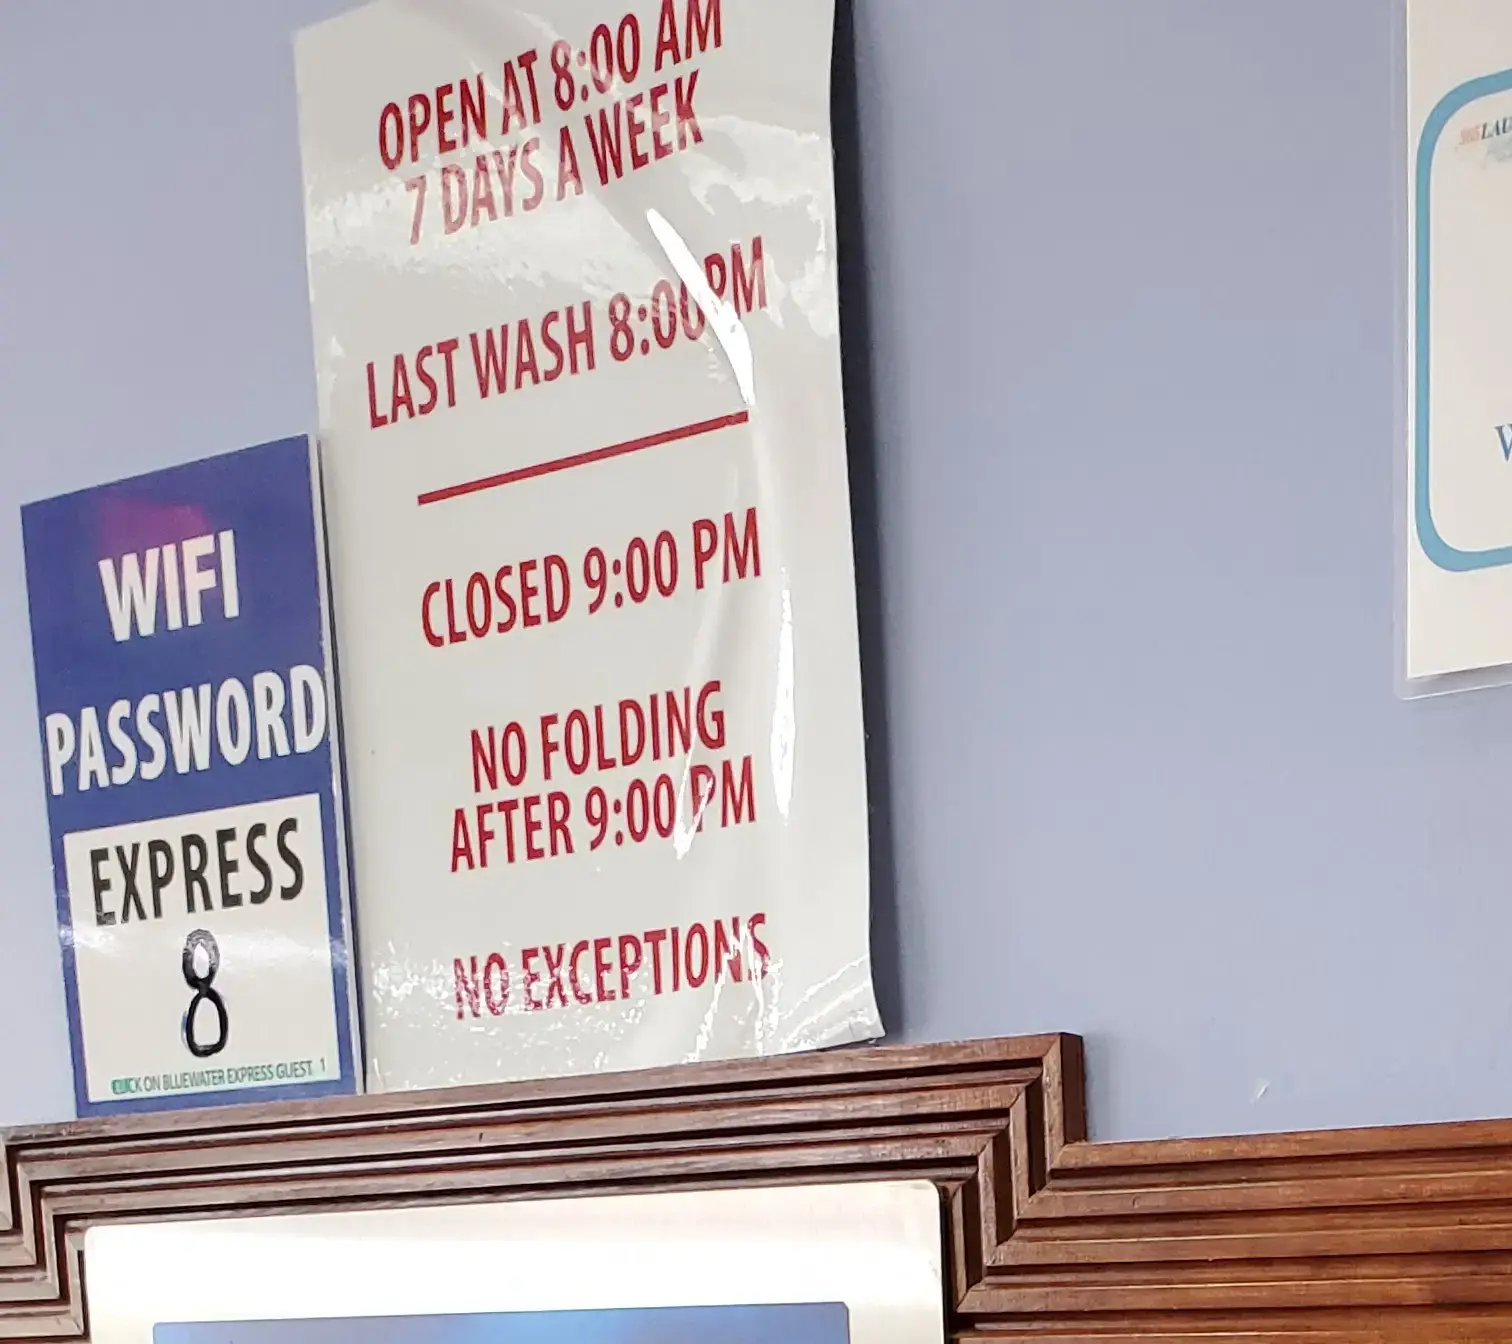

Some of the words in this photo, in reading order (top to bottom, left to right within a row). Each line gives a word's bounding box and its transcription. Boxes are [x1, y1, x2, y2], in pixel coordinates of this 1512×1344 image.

[379, 72, 487, 170] OPEN
[501, 50, 542, 135] AT
[551, 13, 640, 111] 8:00
[653, 0, 723, 71] AM
[405, 176, 427, 245] 7
[443, 137, 544, 236] DAYS
[556, 126, 584, 202] A
[584, 69, 704, 186] WEEK
[366, 339, 457, 430] LAST
[469, 301, 596, 399] WASH
[609, 279, 708, 362] 8:00
[703, 236, 769, 321] PM
[98, 529, 240, 642] WIFI
[422, 553, 571, 647] CLOSED
[583, 530, 678, 615] 9:00
[692, 506, 762, 590] PM
[45, 664, 326, 796] PASSWORD
[470, 722, 527, 793] NO
[540, 680, 726, 780] FOLDING
[89, 816, 304, 926] EXPRESS
[450, 791, 573, 873] AFTER
[585, 773, 676, 850] 9:00
[690, 755, 757, 832] PM
[181, 928, 229, 1058] 8
[452, 953, 512, 1020] NO
[520, 912, 771, 1014] EXCEPTIONS
[143, 1074, 161, 1092] ON
[162, 1069, 226, 1090] BLUEWATER
[226, 1063, 275, 1084] EXPRESS
[275, 1059, 313, 1079] GUEST
